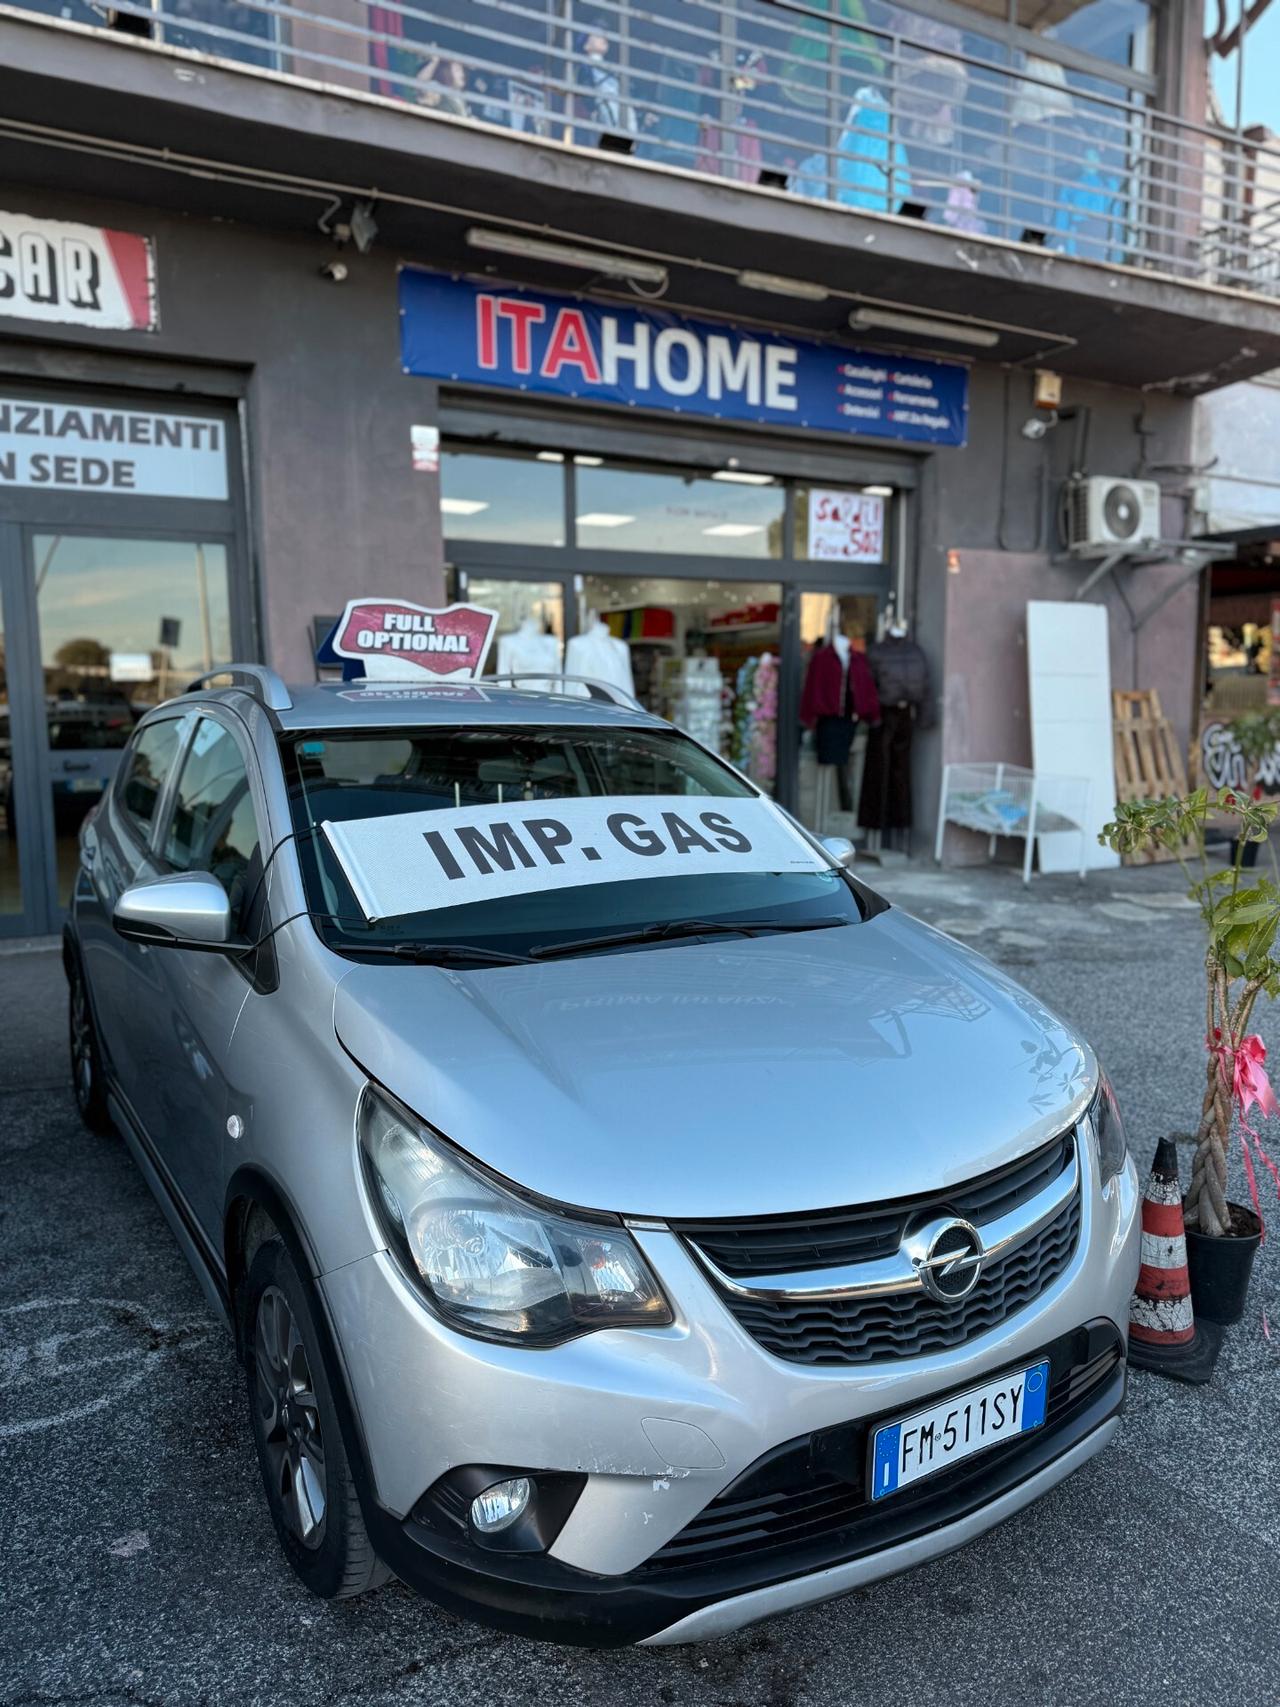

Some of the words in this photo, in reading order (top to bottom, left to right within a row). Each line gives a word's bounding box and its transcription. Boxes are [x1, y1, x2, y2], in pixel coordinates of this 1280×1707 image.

[476, 294, 798, 411] ITAHOME
[30, 453, 136, 489] SEDE
[383, 612, 435, 633] FULL
[356, 630, 470, 653] OPTIONAL
[422, 817, 602, 881] IMP.
[606, 811, 753, 857] GAS
